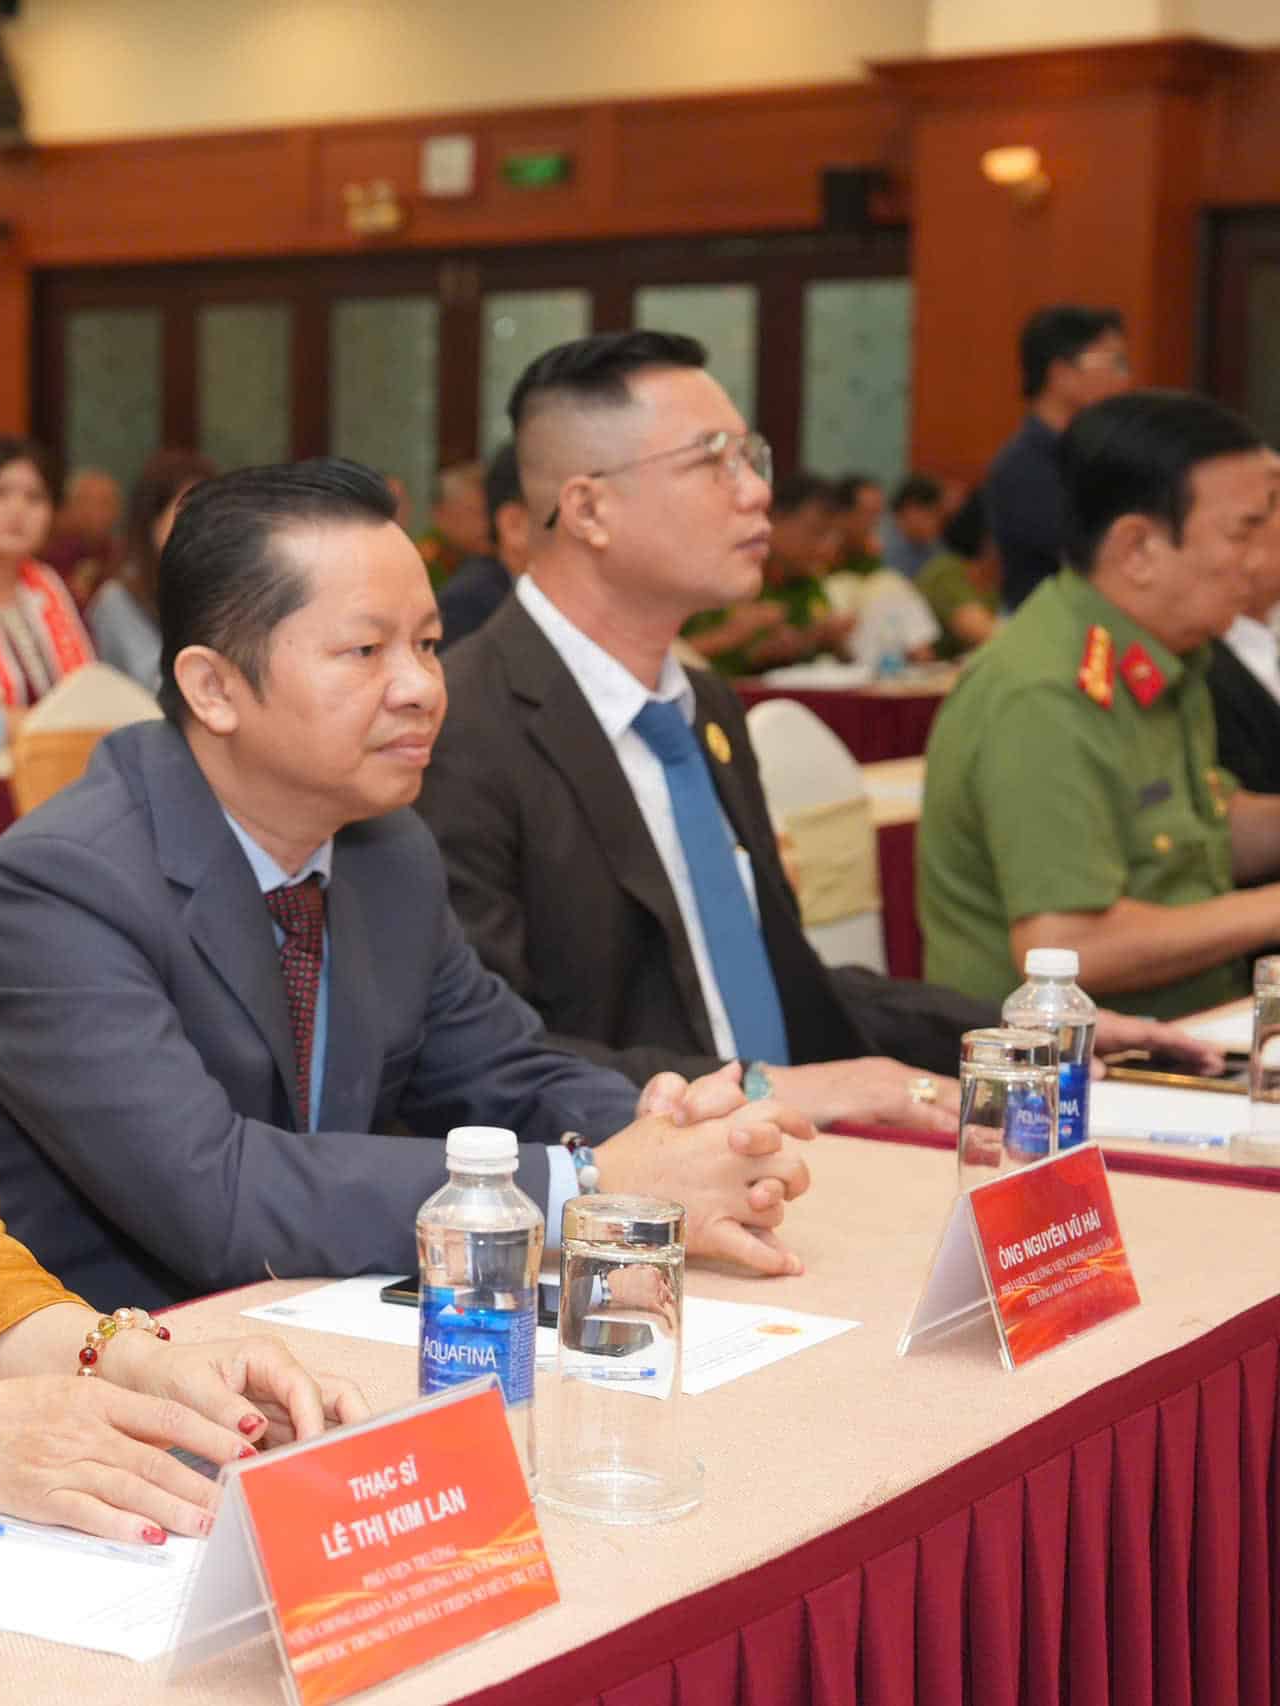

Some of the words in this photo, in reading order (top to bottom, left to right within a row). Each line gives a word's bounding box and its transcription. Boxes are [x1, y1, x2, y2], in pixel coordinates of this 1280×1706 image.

[998, 1242, 1024, 1270] ÔNG
[423, 1336, 497, 1368] AQUAFINA
[348, 1466, 398, 1502] THẠC
[399, 1454, 418, 1485] SĨ
[321, 1520, 353, 1560] LÊ
[351, 1514, 390, 1548] THỊ
[386, 1500, 426, 1536] KIM
[424, 1485, 467, 1521] LAN
